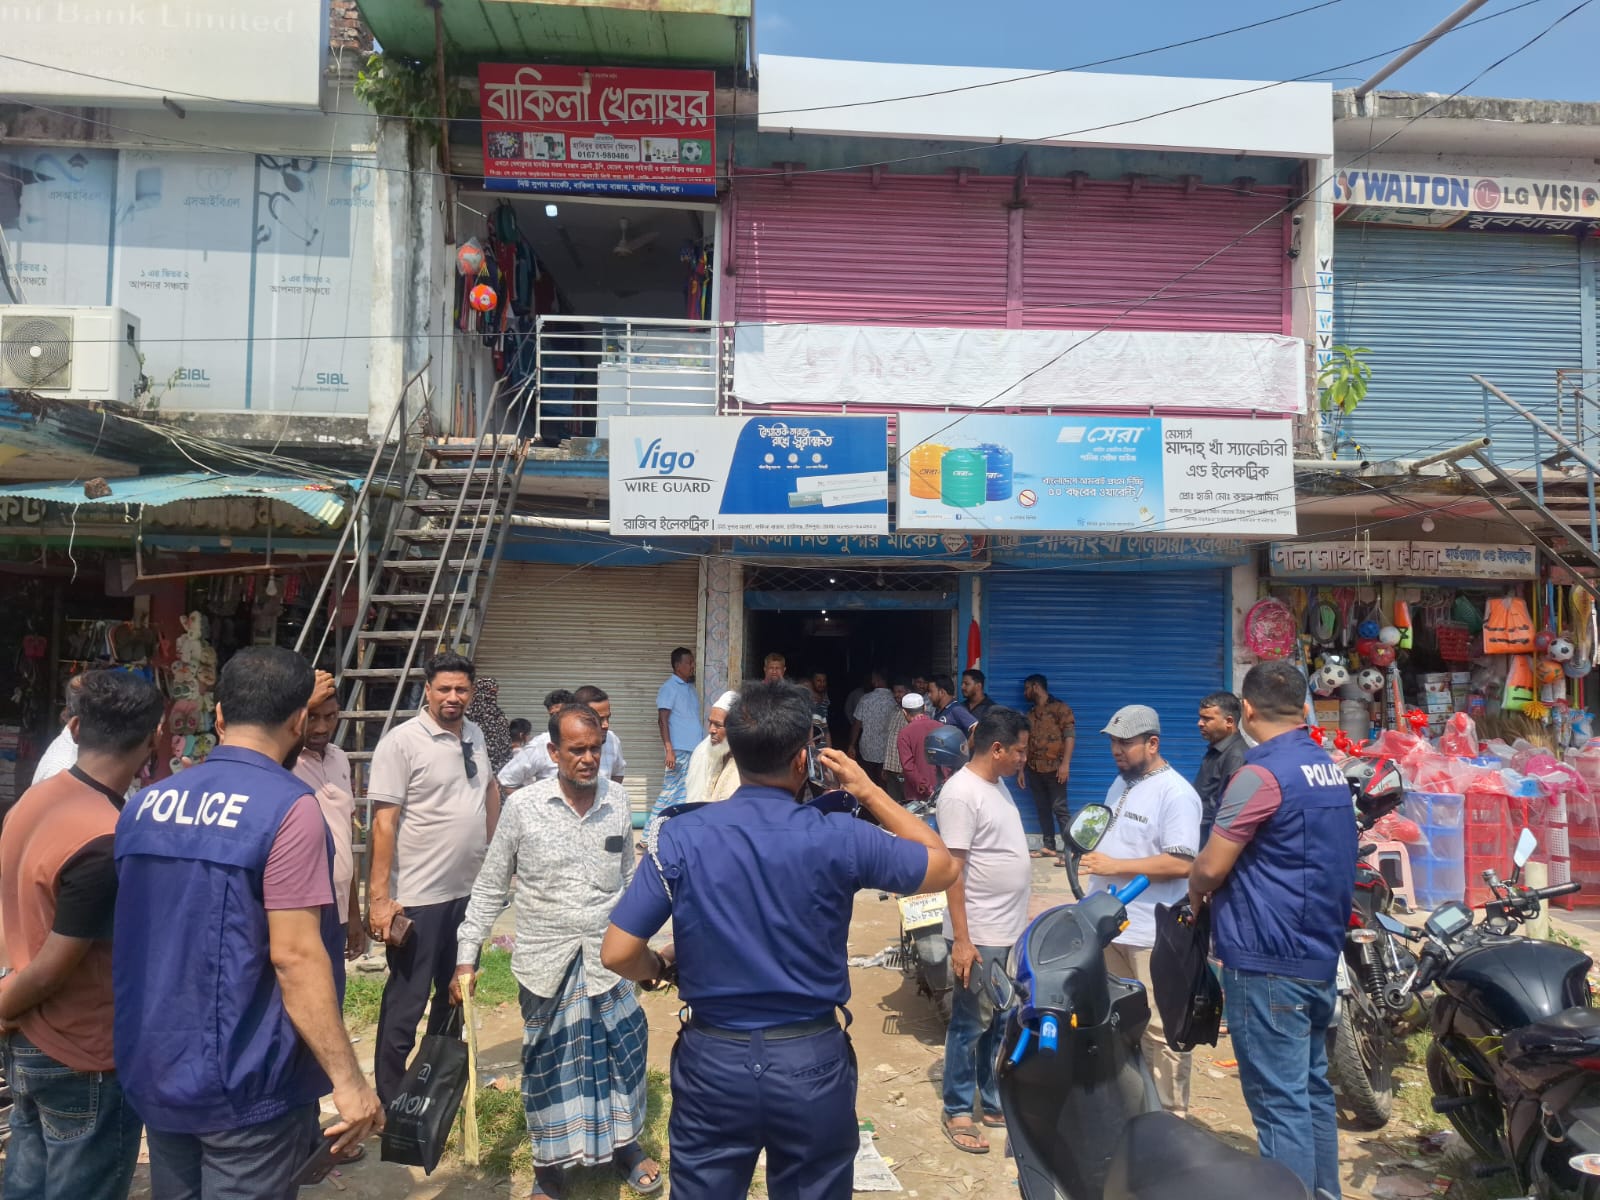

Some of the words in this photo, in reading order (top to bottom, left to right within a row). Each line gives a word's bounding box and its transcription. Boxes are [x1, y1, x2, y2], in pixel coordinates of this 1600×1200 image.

[57, 1, 145, 26] Bank
[161, 2, 294, 33] Limited
[484, 67, 591, 122] বাকিলা
[600, 86, 709, 127] খেলাঘর
[1363, 171, 1469, 208] WALTON
[1503, 187, 1529, 205] LG
[129, 280, 161, 290] আপনার
[179, 368, 210, 381] SIBL
[316, 372, 349, 385] SIBL
[1088, 427, 1144, 443] সেরা
[1165, 427, 1193, 440] মেসার্স
[634, 436, 695, 475] Vigo
[1208, 438, 1223, 456] খাঁ
[1227, 438, 1288, 457] স্যানেটারী
[1210, 461, 1270, 480] ইলেকট্রিক
[624, 482, 657, 493] WIRE
[663, 482, 711, 493] GUARD
[1196, 489, 1213, 501] হাজী
[623, 515, 657, 531] রাজিব
[660, 515, 711, 532] ইলেকট্রিক
[1274, 549, 1312, 571] পাল
[135, 789, 249, 828] POLICE
